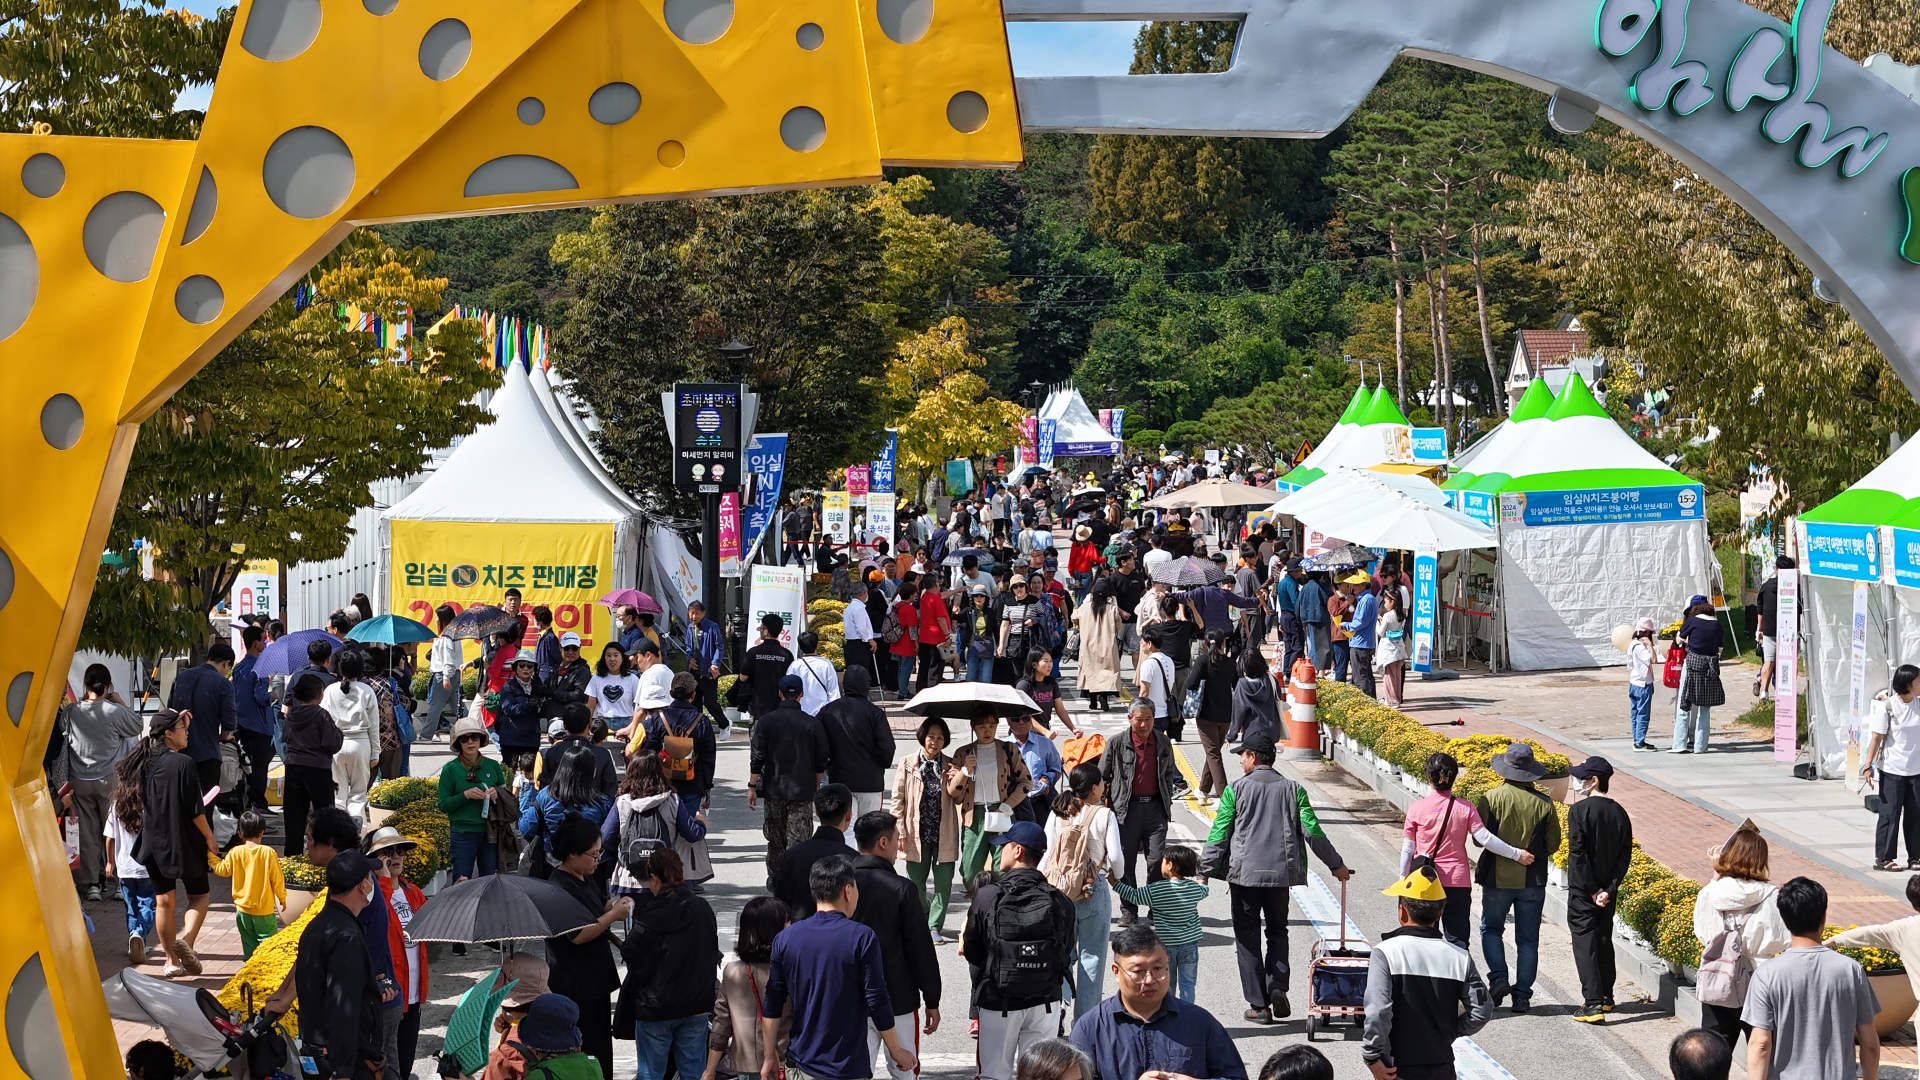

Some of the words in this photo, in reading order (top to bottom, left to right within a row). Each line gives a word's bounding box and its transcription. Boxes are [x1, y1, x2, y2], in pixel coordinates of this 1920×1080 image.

[682, 451, 711, 459] 미세먼지
[712, 451, 734, 459] 알리미
[751, 453, 782, 473] 임실
[759, 473, 774, 491] N
[850, 471, 867, 482] 축제
[873, 471, 892, 481] 축제
[720, 495, 734, 513] 즈
[1563, 491, 1640, 505] 임실N치즈붕어빵
[1679, 495, 1696, 504] 15-2
[827, 512, 844, 522] 임실
[1530, 507, 1562, 516] 임실에서만
[1644, 503, 1673, 511] 맛보세요!!
[750, 511, 767, 531] 축
[404, 562, 447, 587] 임실
[482, 564, 525, 588] 치즈
[532, 563, 598, 589] 판매장
[1418, 564, 1433, 580] 임실
[1420, 582, 1429, 598] N
[1417, 599, 1432, 615] 치즈
